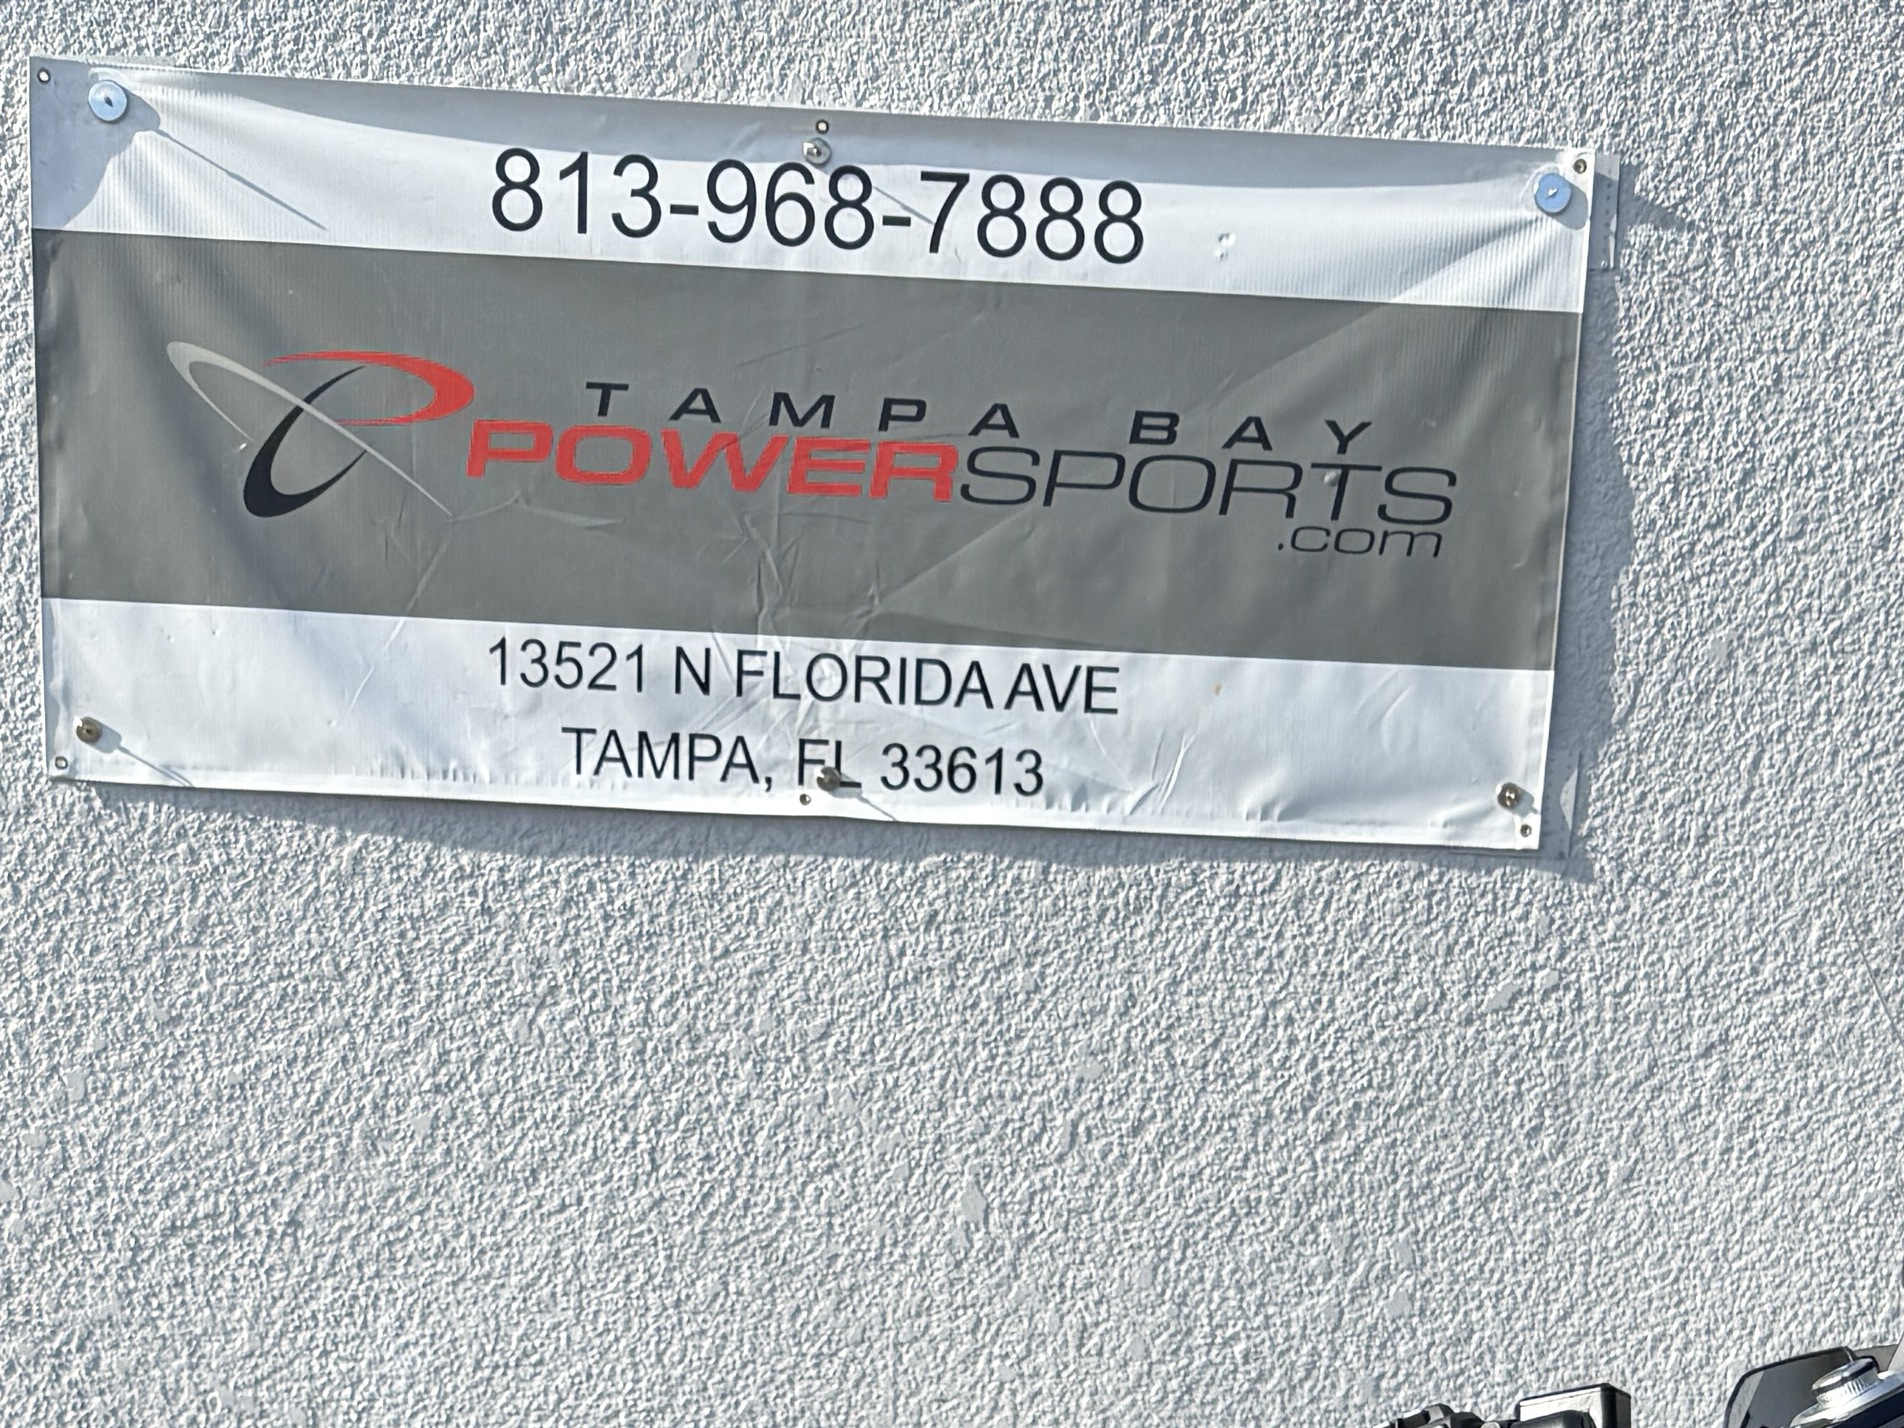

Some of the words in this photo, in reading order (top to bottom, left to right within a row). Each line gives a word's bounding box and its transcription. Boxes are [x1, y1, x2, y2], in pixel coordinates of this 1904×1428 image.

[491, 147, 1144, 264] 813-968-7888
[585, 381, 1020, 439] TAMPA
[1129, 410, 1372, 455] BAY
[467, 418, 1457, 526] POWERSPORTS
[1278, 526, 1443, 558] .com
[489, 636, 644, 692] 13521
[674, 646, 712, 696] N
[736, 649, 995, 709] FLORIDA
[1004, 663, 1120, 715] AVE
[561, 727, 773, 792] TAMPA,
[798, 738, 862, 788] FL
[880, 743, 1044, 797] 33613
